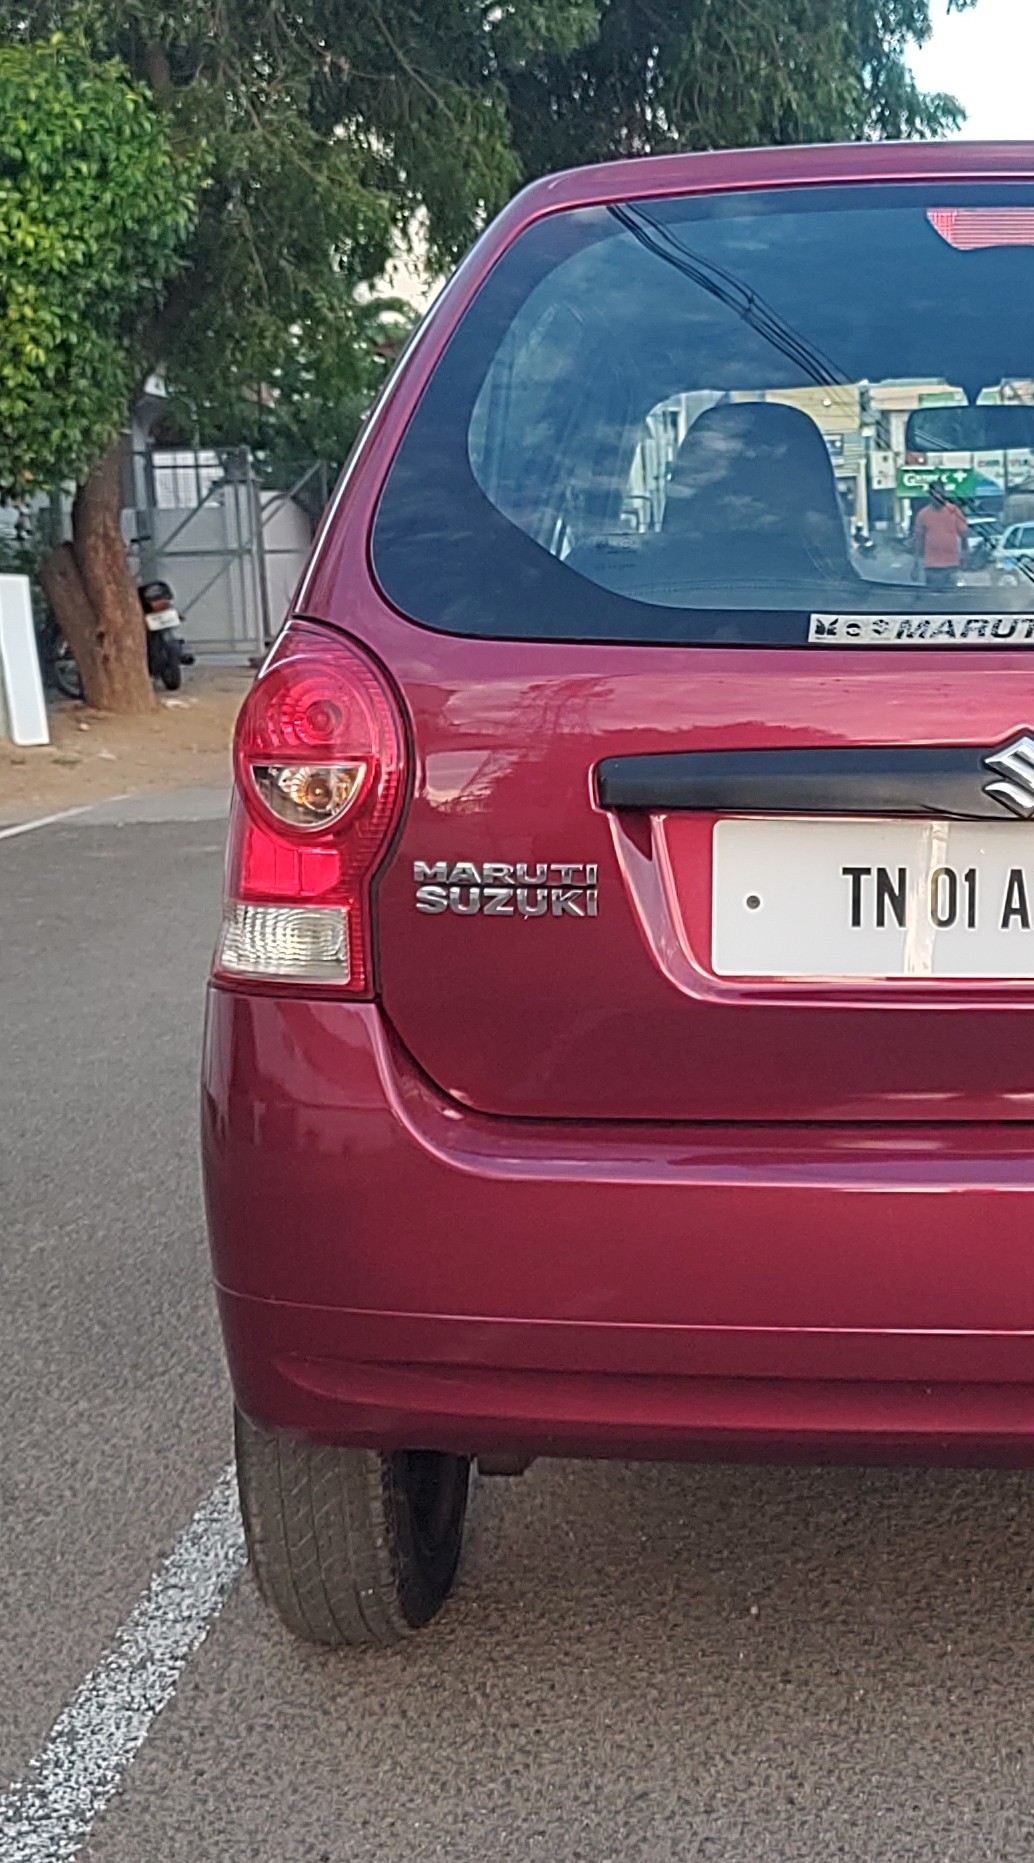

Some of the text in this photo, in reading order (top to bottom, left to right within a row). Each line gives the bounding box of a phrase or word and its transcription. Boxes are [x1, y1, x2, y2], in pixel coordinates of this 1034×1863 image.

[413, 860, 598, 885] MARUTI
[415, 886, 598, 917] SUZUKI
[842, 867, 907, 928] TN
[930, 867, 976, 929] 01
